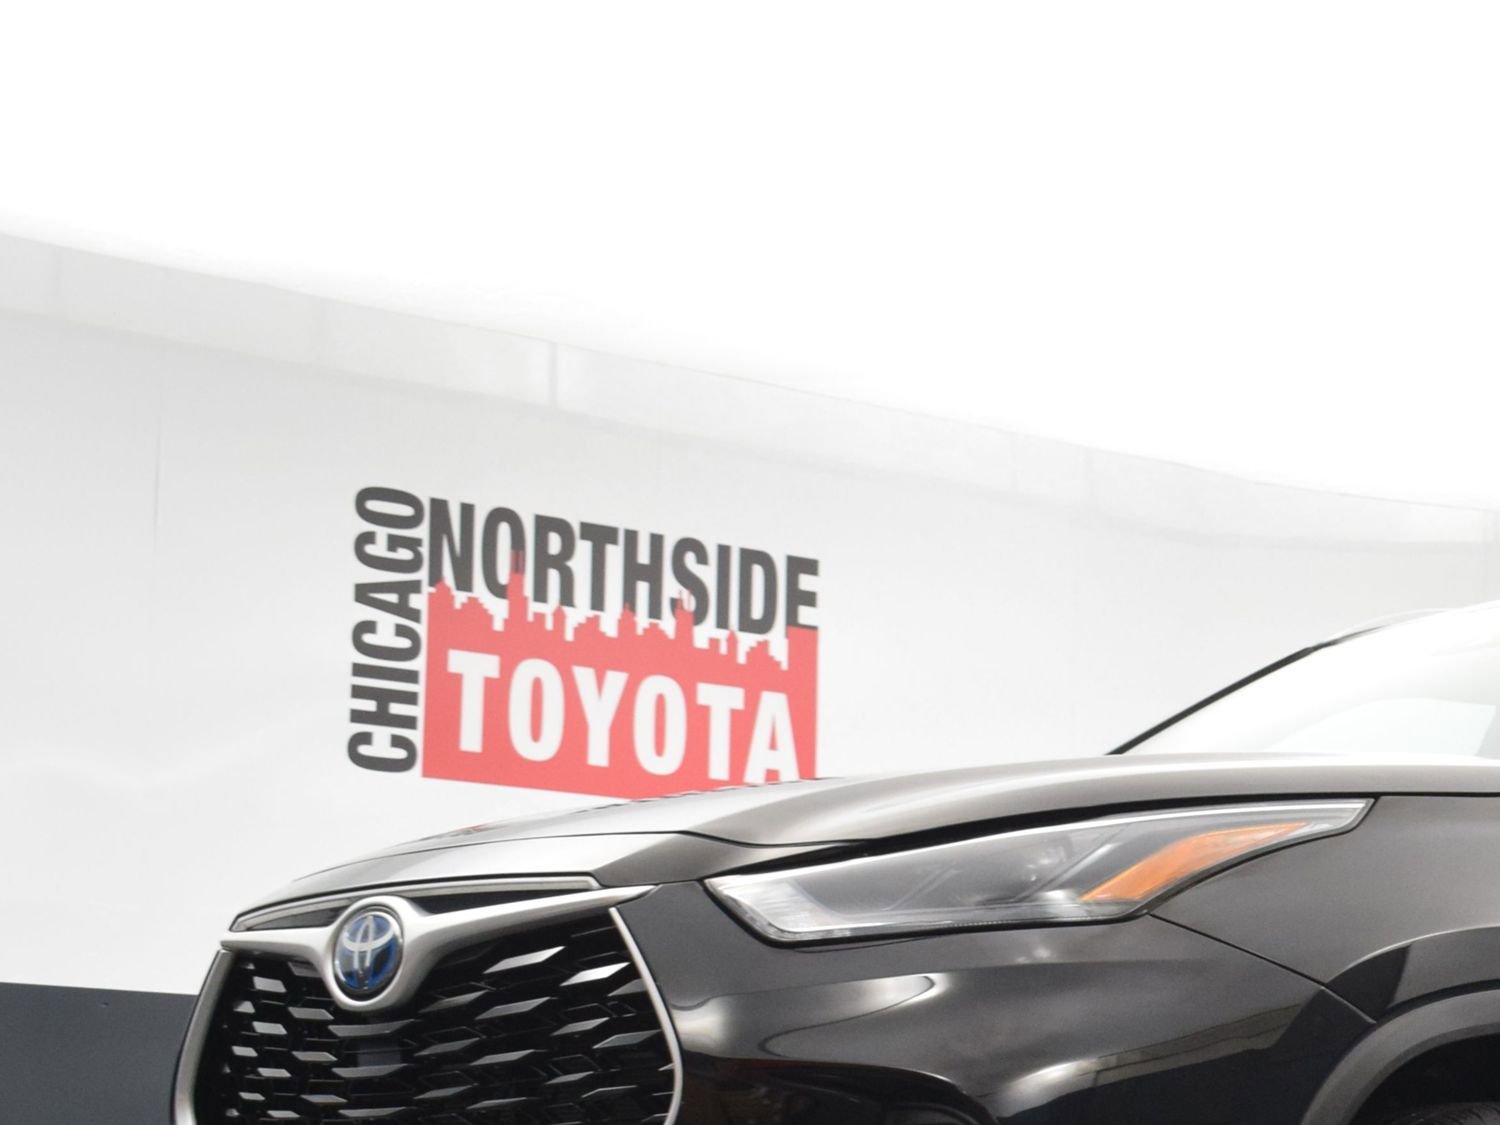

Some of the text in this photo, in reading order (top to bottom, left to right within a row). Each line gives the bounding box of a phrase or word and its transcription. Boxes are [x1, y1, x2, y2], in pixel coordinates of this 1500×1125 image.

[347, 486, 425, 773] CHICAGO
[428, 497, 819, 635] NORTHSIDE
[447, 649, 800, 784] TOYOTA
